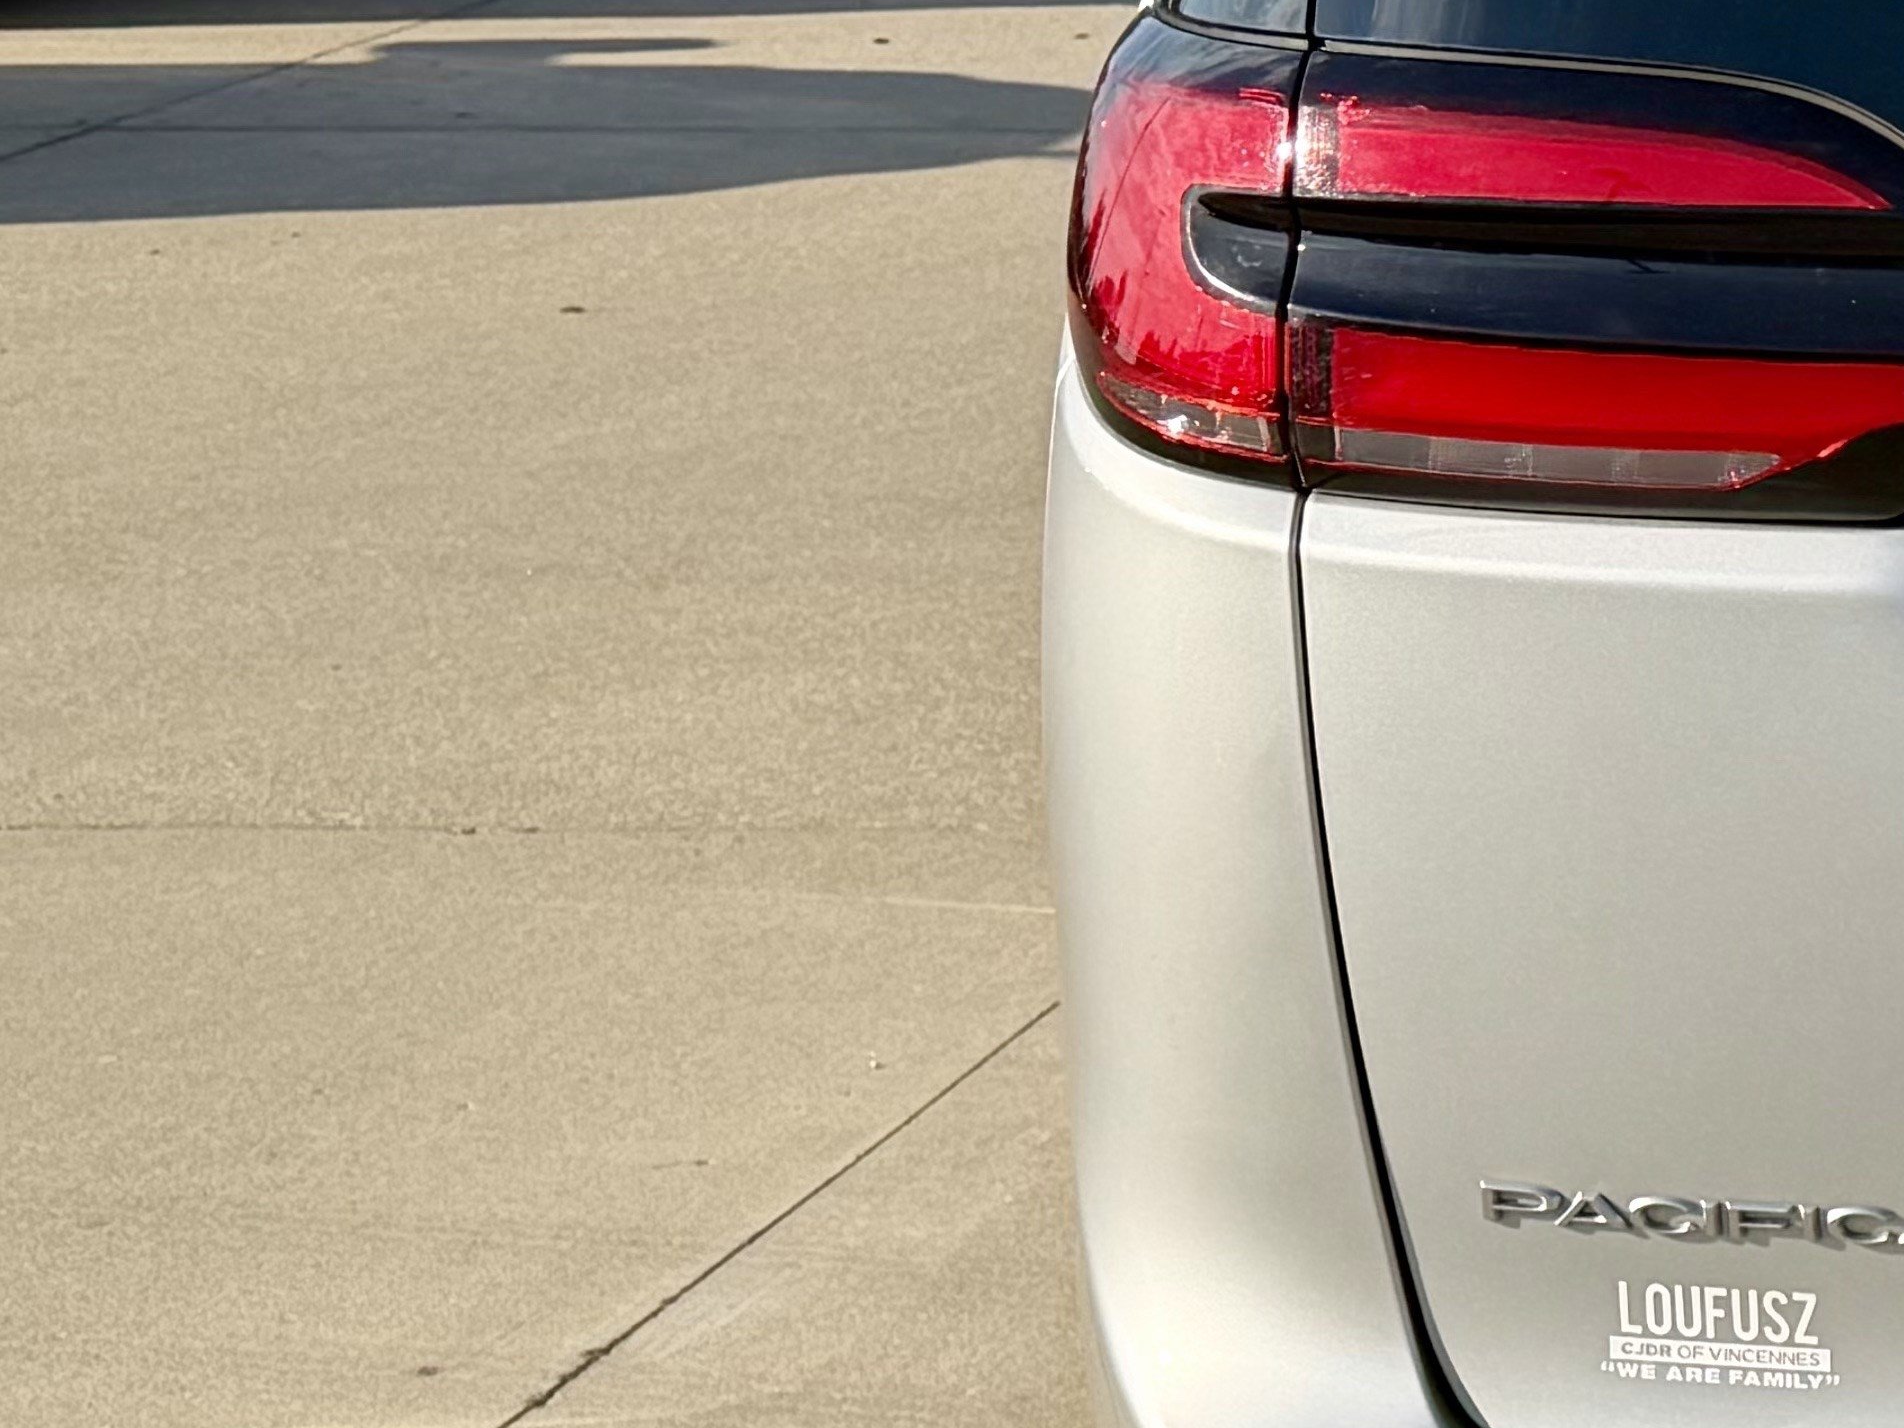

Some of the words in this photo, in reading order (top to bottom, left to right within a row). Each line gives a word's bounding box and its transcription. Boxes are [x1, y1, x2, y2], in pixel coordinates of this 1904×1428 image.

[1620, 1341, 1673, 1358] CJDR
[1676, 1345, 1705, 1360] OF
[1708, 1346, 1822, 1368] VINCENNES
[1665, 1365, 1721, 1385] ARE
